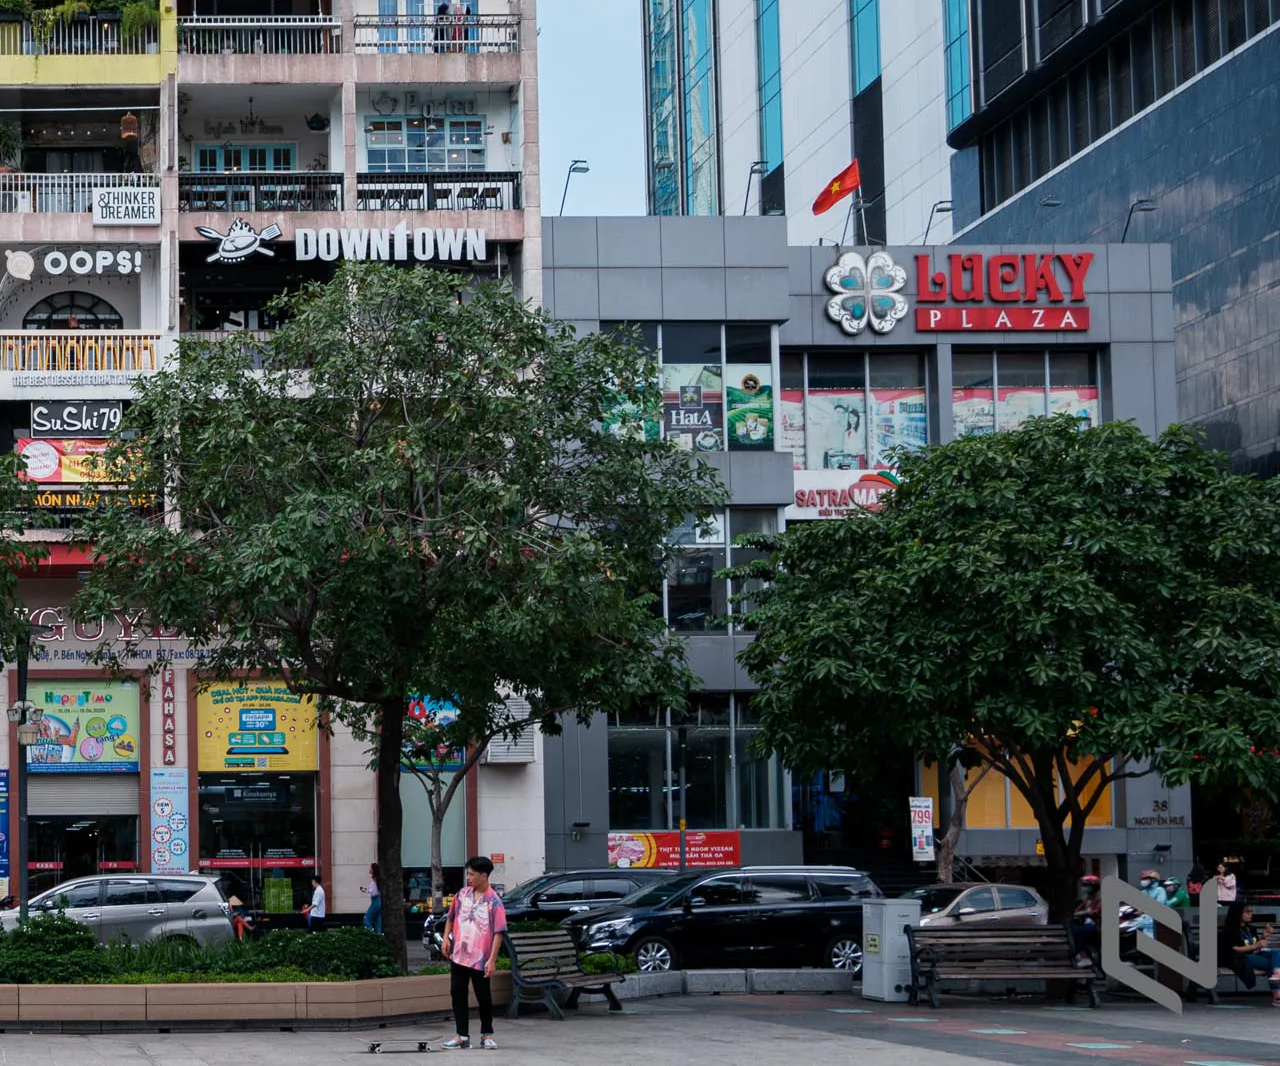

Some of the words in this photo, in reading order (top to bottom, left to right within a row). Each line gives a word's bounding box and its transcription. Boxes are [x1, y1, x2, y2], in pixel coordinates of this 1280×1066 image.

[106, 192, 155, 205] THINKER
[101, 205, 156, 219] DREAMER
[44, 250, 142, 274] OOPS!
[914, 252, 1095, 302] LUCKY
[929, 309, 1078, 328] PLAZA
[13, 375, 27, 386] THE
[30, 375, 48, 386] BEST
[51, 375, 84, 386] DESSERT
[671, 410, 712, 425] HatA
[796, 489, 849, 507] SATRA
[162, 669, 175, 764] FAHASA
[1152, 800, 1168, 812] 38
[911, 810, 931, 823] 799
